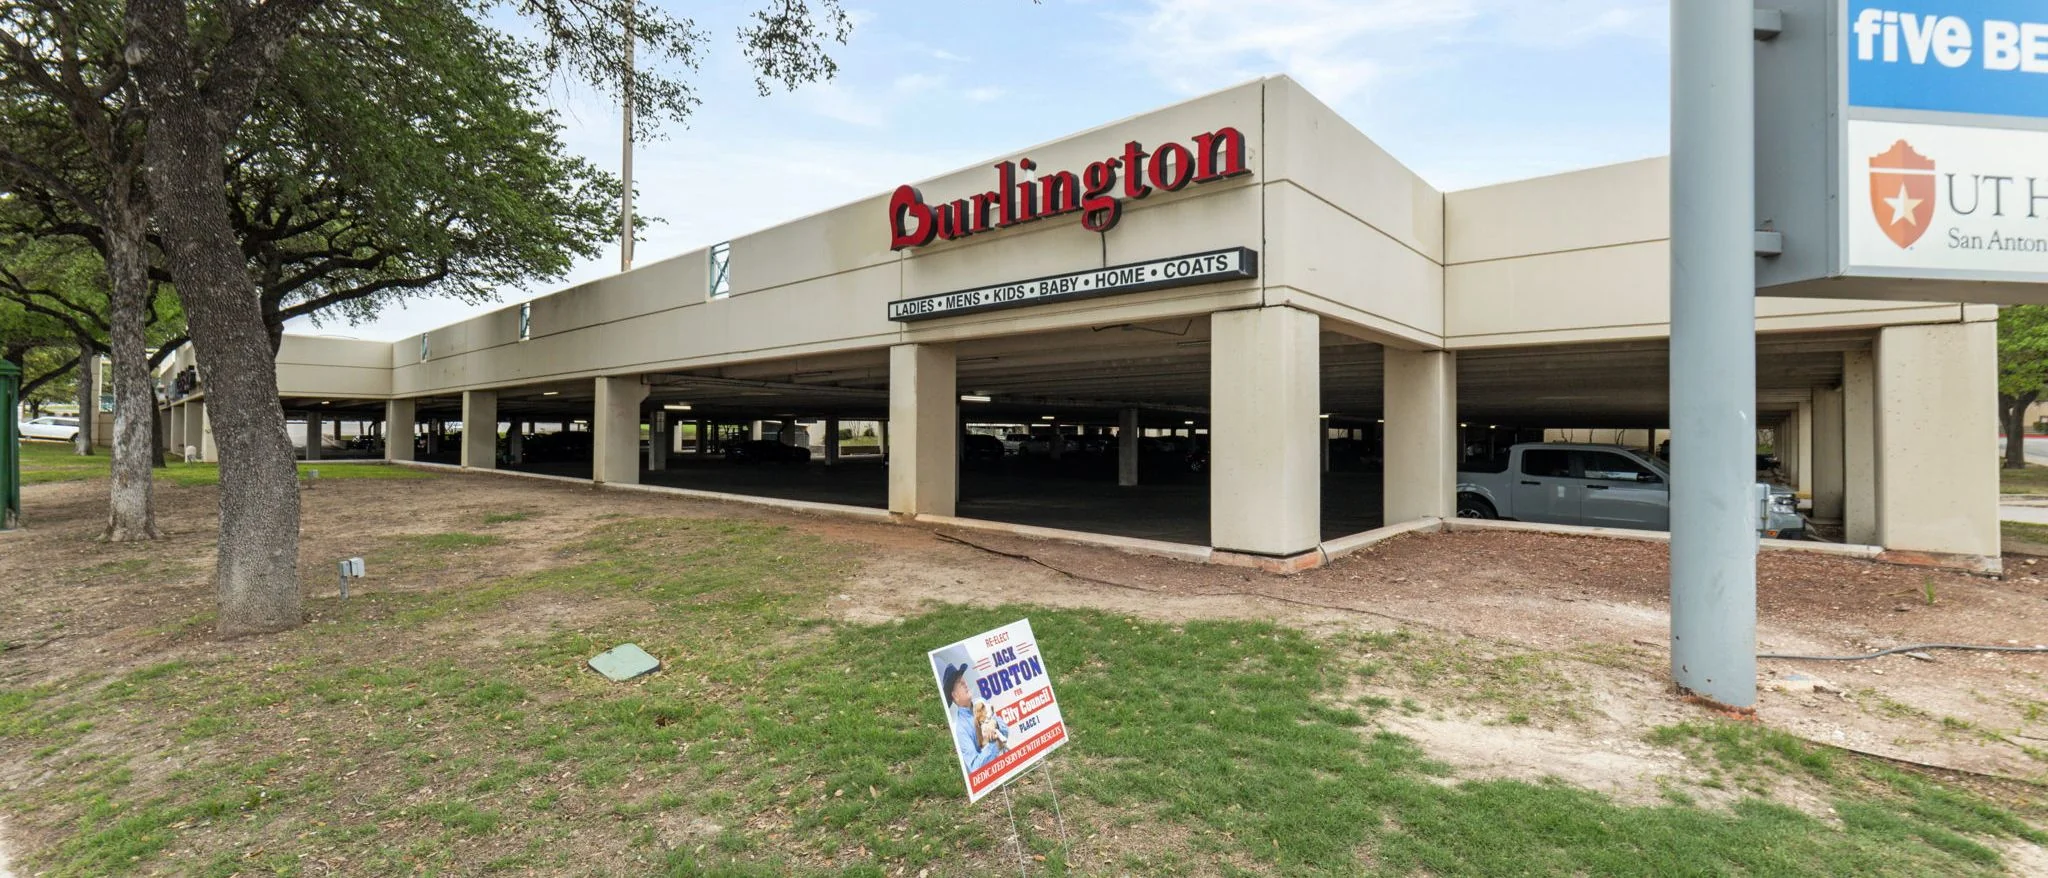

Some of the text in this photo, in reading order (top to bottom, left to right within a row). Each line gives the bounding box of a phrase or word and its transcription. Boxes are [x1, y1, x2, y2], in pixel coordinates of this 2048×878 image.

[889, 126, 1253, 252] Burlington
[1944, 172, 2014, 216] UT
[1947, 226, 2048, 253] San Anton
[895, 254, 1228, 317] LADIES MENS KIDS BABY HOME COATS
[985, 632, 1010, 648] RE-ELECT
[992, 646, 1017, 667] JACK
[976, 655, 1042, 700] BURTON
[1001, 687, 1051, 724] City Council
[1018, 716, 1037, 734] PLACE
[972, 727, 1062, 786] DEDICATED SERVICE WITH RESULTS
